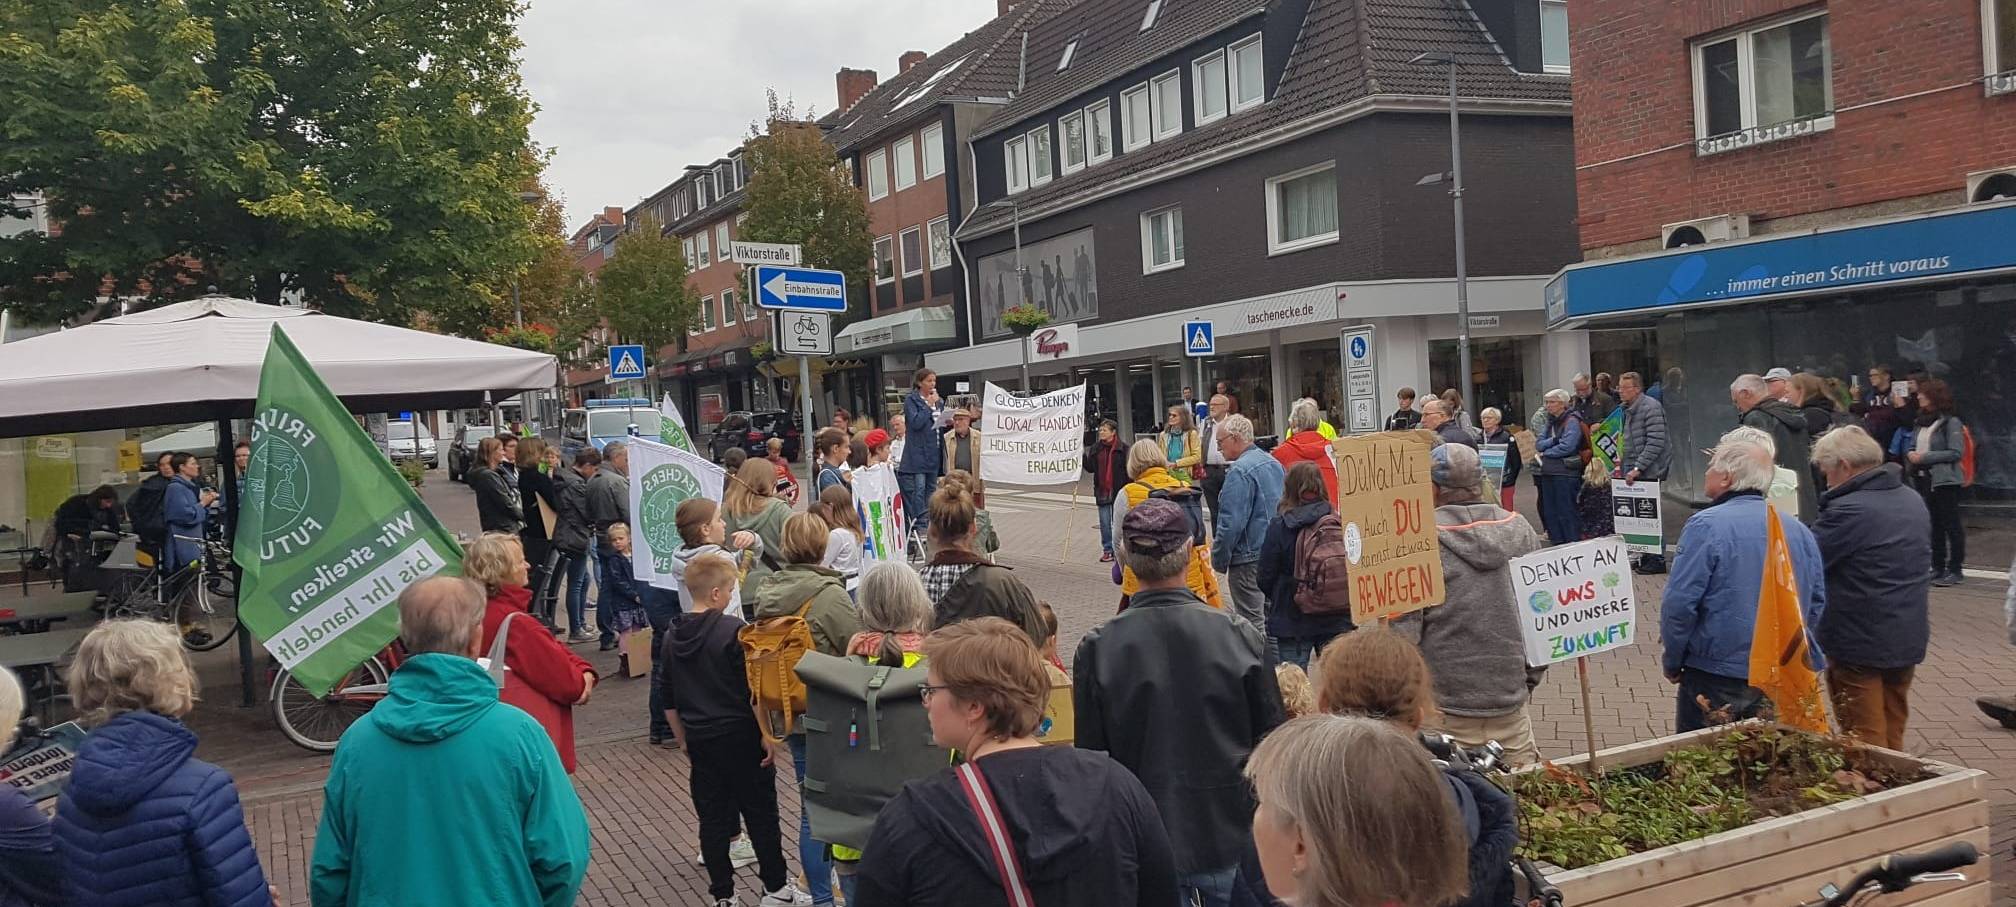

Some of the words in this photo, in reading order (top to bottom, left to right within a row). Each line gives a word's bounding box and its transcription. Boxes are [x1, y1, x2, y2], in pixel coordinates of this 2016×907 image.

[736, 246, 790, 260] Viktorstraße
[1781, 271, 1825, 286] einen
[1829, 261, 1886, 281] Schritt
[1889, 256, 1951, 273] voraus
[785, 284, 840, 296] Einbahnstraße
[1247, 303, 1314, 324] taschenecke.de
[995, 394, 1037, 408] GLOBAL
[997, 414, 1034, 432] LOKAL
[1040, 412, 1083, 431] HANDELN
[990, 438, 1046, 454] HOLSTENER
[1051, 438, 1077, 453] ALLEE
[1363, 508, 1389, 538] Auch
[1393, 498, 1421, 536] DU
[1395, 536, 1430, 559] etwas
[1520, 556, 1584, 586] DENKT
[1593, 545, 1618, 568] AN
[1357, 563, 1433, 613] BEWEGEN
[1558, 580, 1595, 606] UNS
[1535, 613, 1569, 631] UND
[1574, 598, 1629, 622] UNSERE
[1548, 622, 1630, 658] ZUKUNFT
[32, 758, 74, 780] ubere
